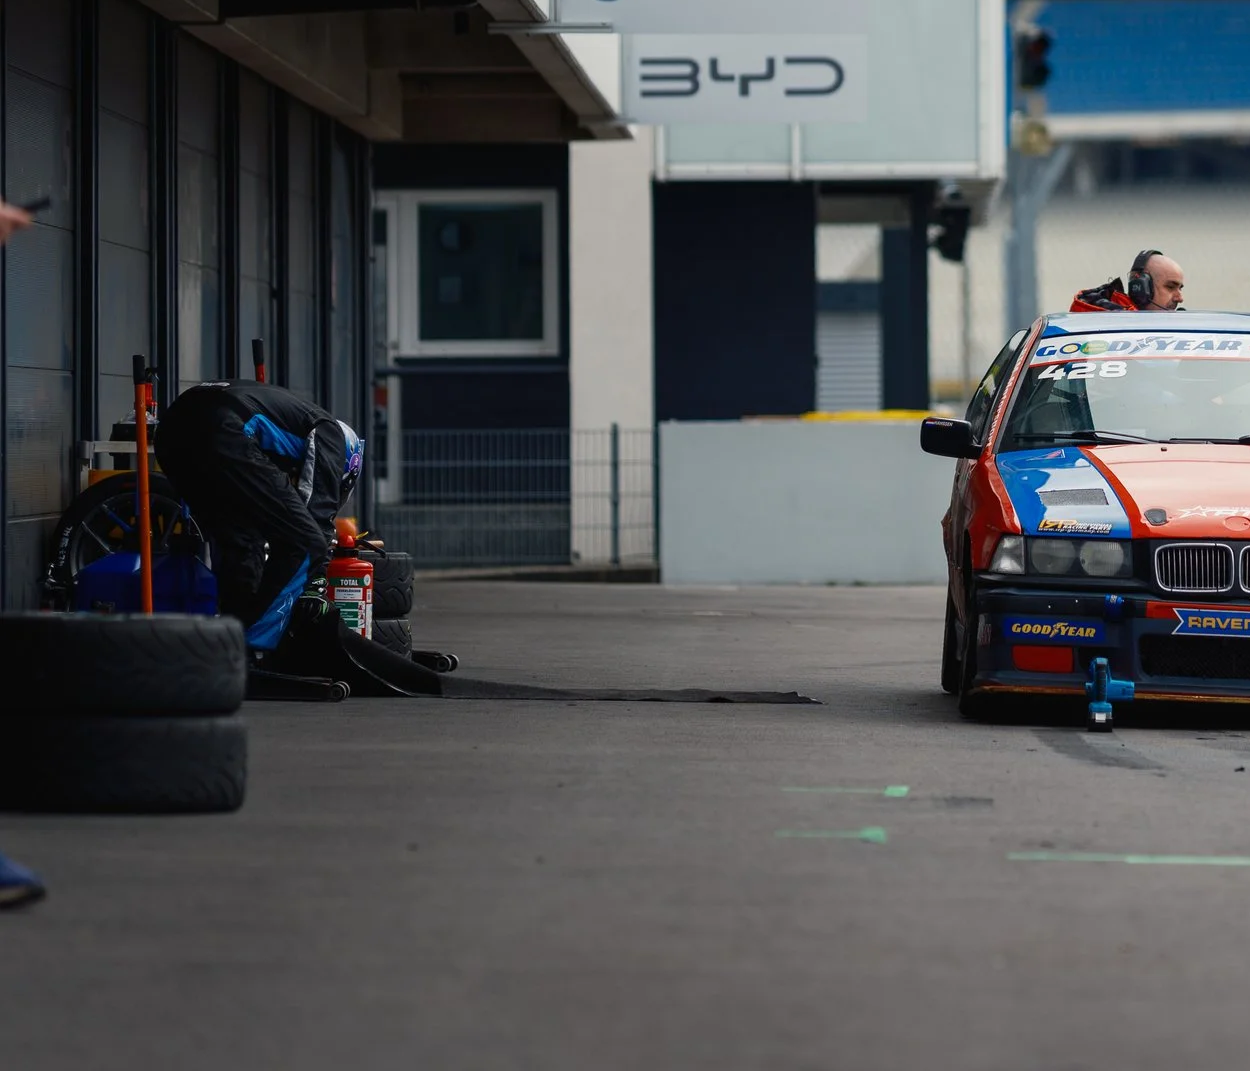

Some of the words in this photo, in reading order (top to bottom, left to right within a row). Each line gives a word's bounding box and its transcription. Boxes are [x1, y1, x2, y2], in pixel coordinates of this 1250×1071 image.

[639, 57, 845, 98] BYD
[1038, 360, 1128, 380] 428
[1012, 622, 1096, 638] GOODYEAR
